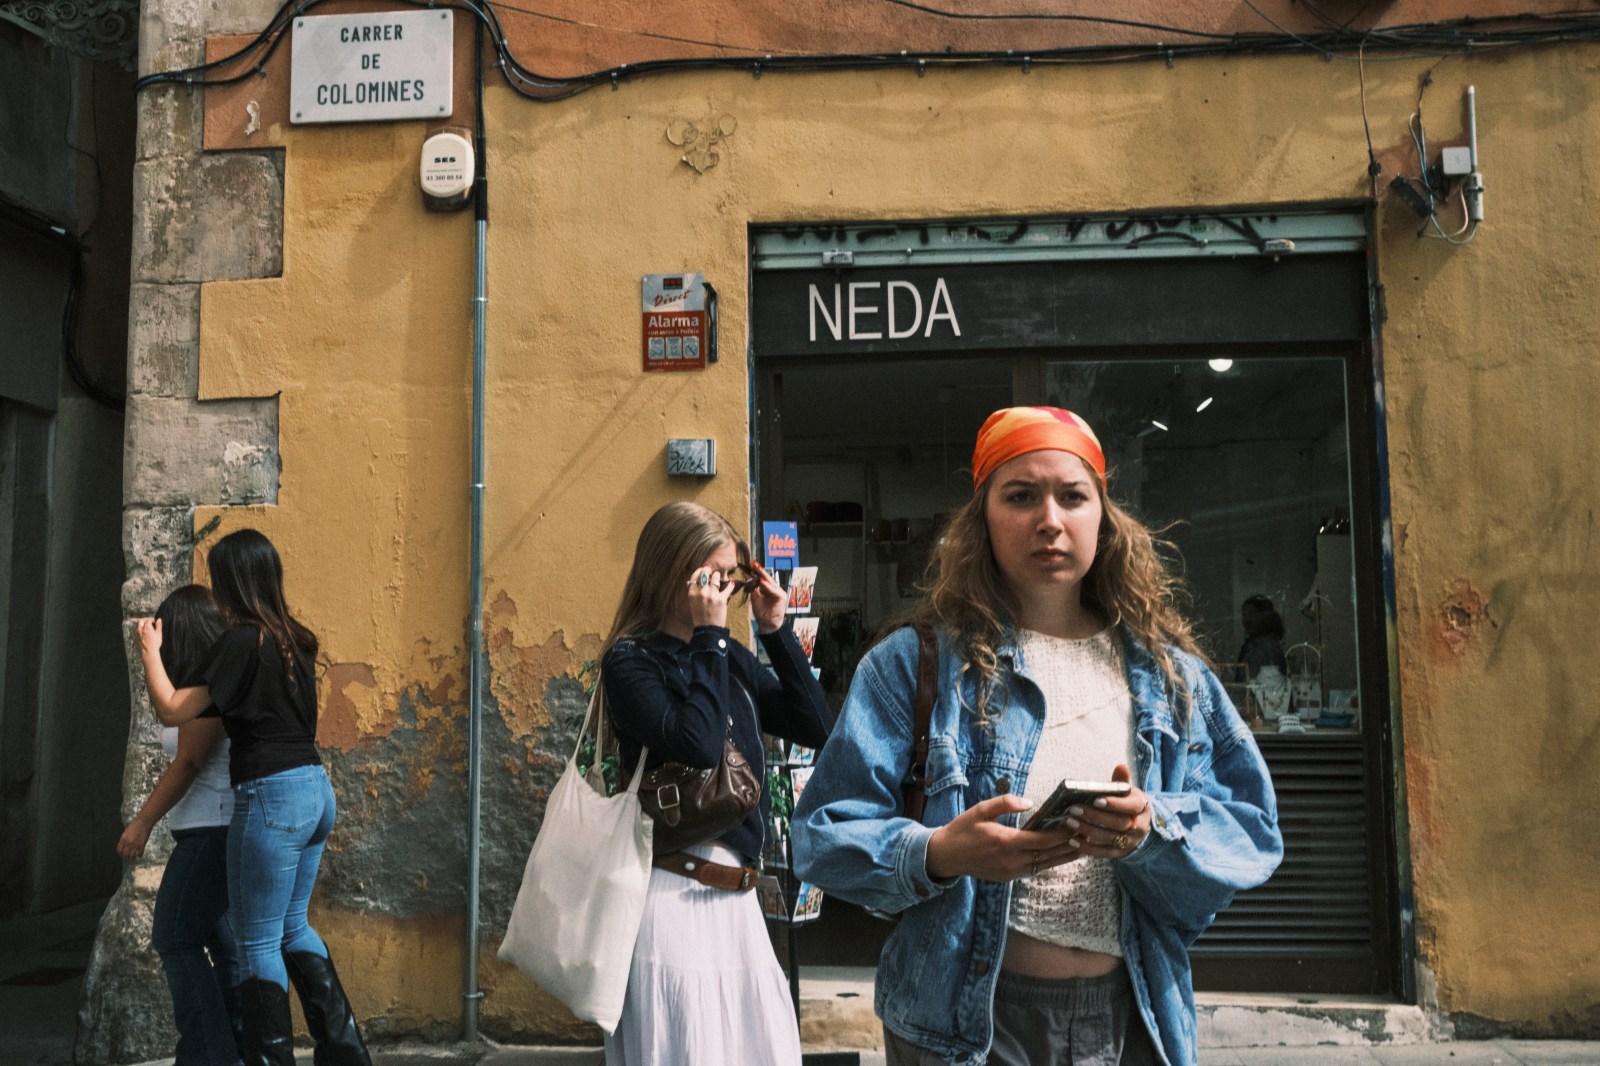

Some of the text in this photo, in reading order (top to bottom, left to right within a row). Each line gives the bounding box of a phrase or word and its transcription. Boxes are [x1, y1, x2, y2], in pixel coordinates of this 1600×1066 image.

[340, 24, 403, 43] CARRER
[361, 53, 381, 70] DE
[317, 79, 425, 105] COLOMINES
[653, 289, 693, 307] Direct
[809, 277, 962, 342] NEDA
[648, 315, 699, 328] Alarma
[768, 533, 796, 550] Hola
